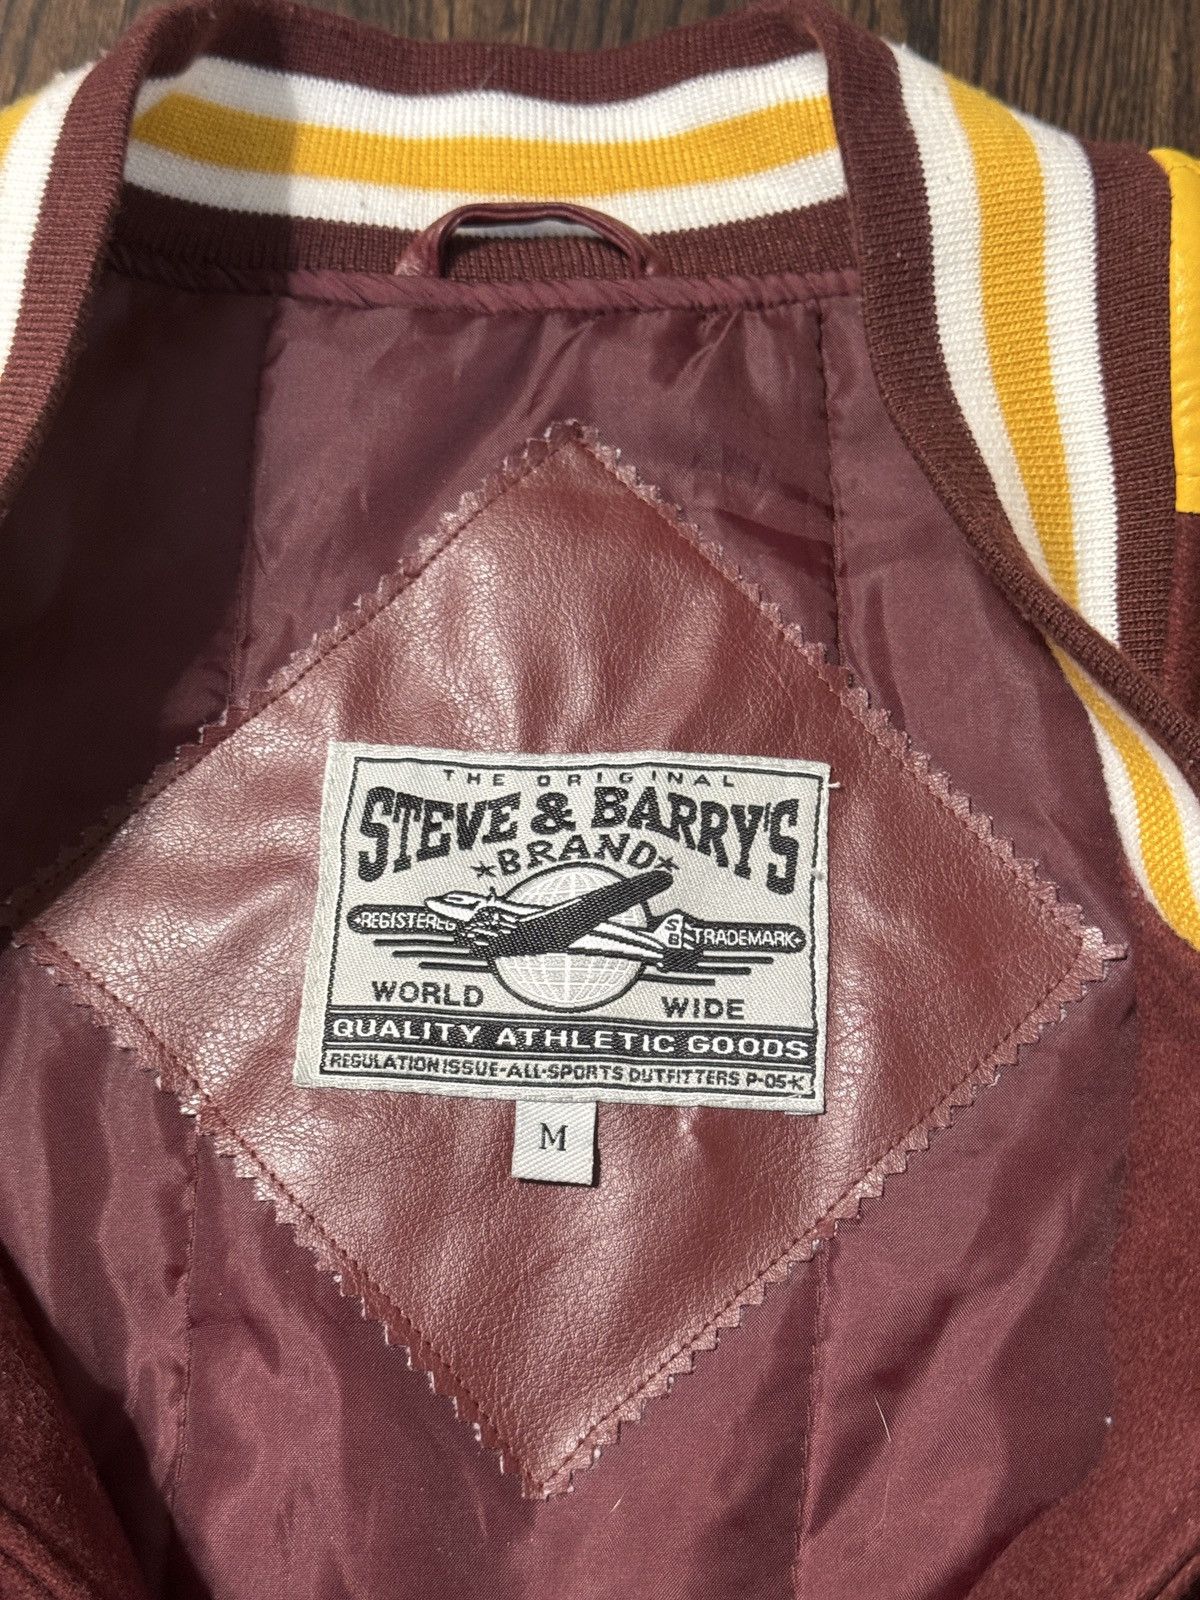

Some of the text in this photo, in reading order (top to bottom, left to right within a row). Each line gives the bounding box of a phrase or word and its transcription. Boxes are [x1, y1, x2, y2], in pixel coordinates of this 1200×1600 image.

[443, 769, 735, 788] THE ORIGINAL
[358, 786, 799, 895] STEVE & BARRY'S
[497, 834, 657, 875] BRAND
[693, 927, 796, 948] TRADEMARK
[371, 980, 745, 1020] WORLD WIDE
[332, 1018, 809, 1058] QUALITY ATHLETIC GOODS
[330, 1053, 440, 1074] REGULATION
[629, 1067, 740, 1086] OUTFITTERS
[538, 1122, 568, 1151] M
